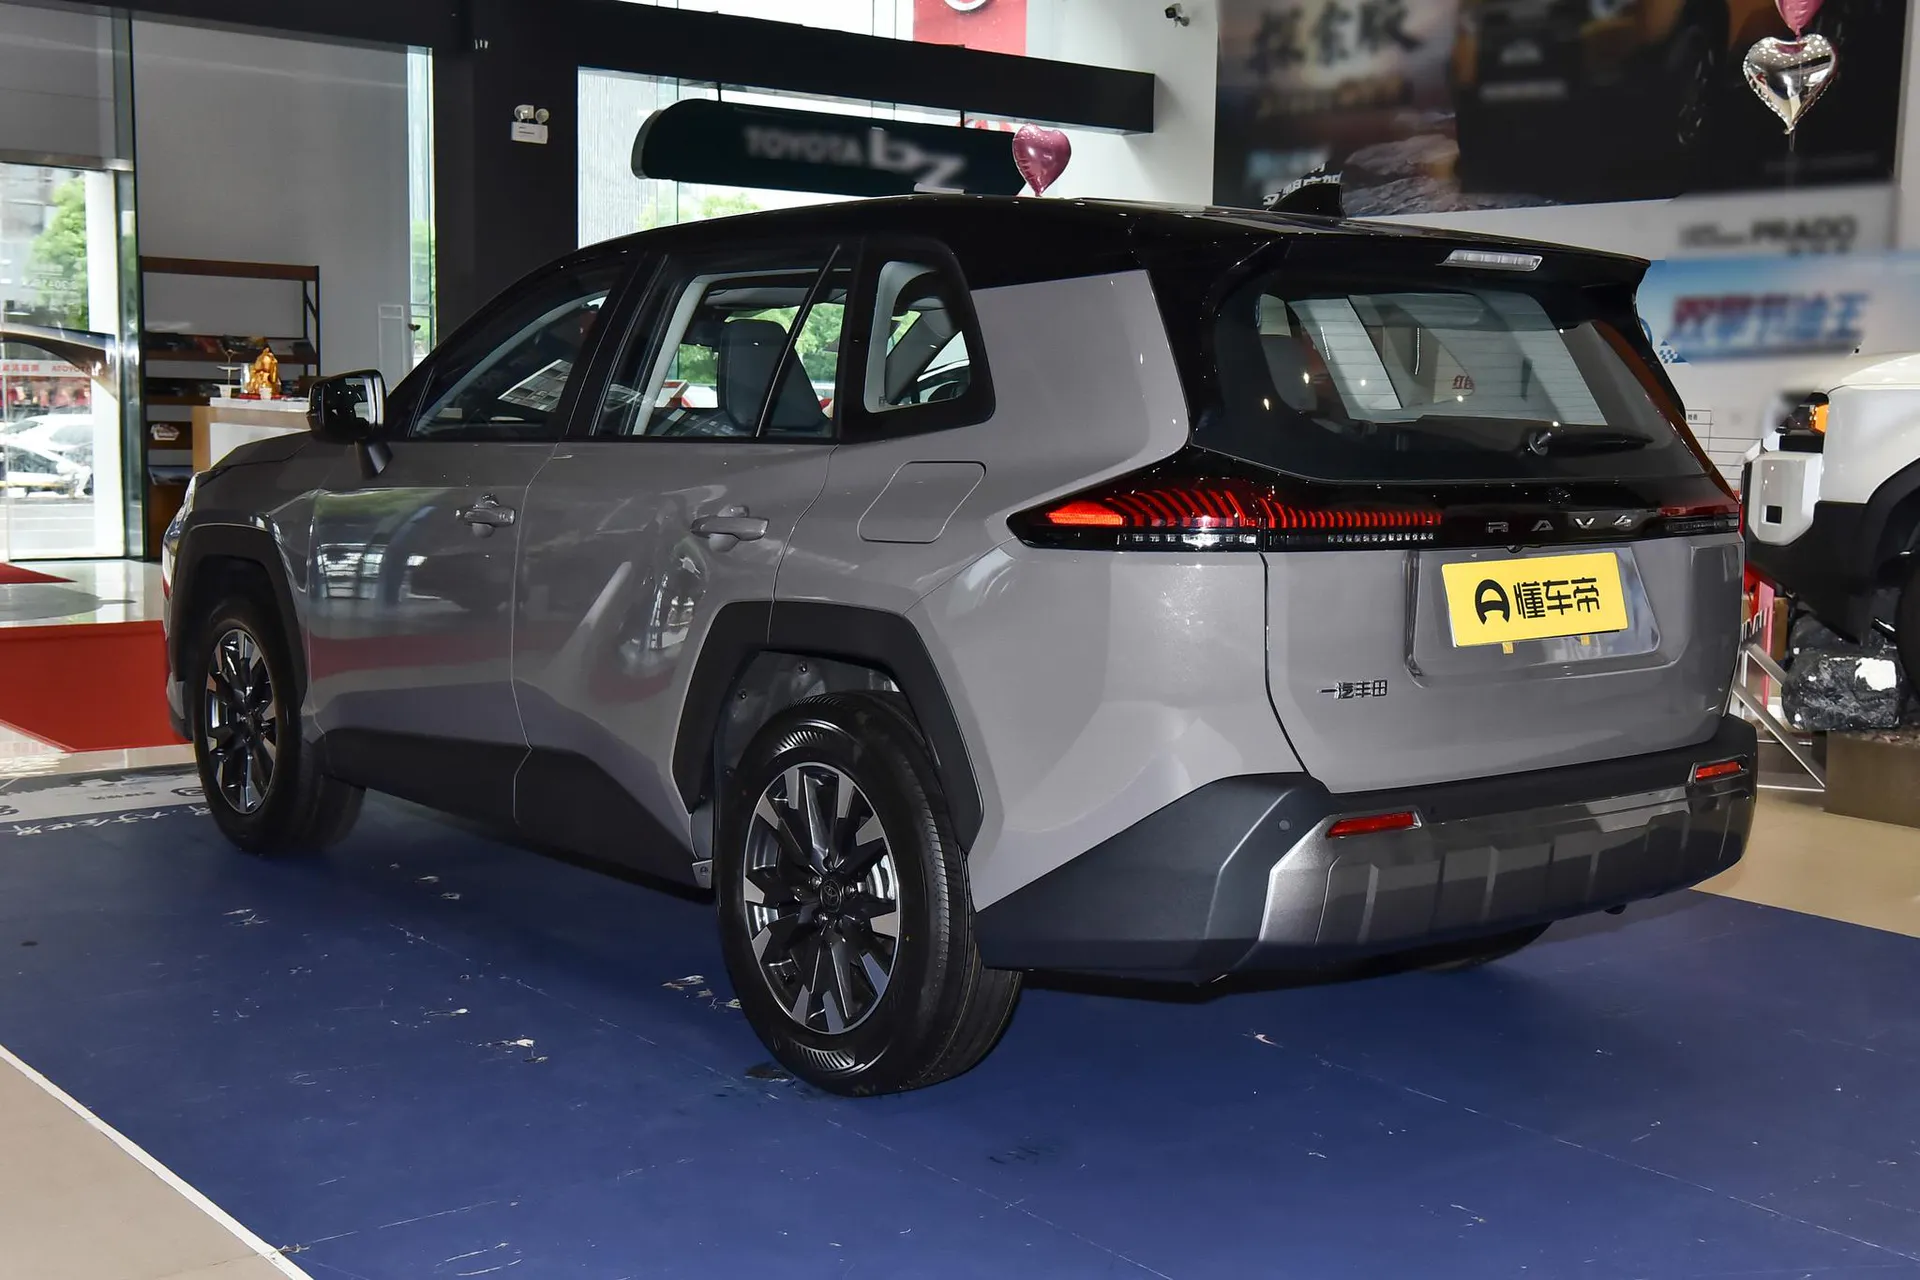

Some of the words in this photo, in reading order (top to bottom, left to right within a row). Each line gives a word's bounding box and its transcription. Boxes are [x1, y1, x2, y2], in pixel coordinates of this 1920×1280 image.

[744, 127, 862, 166] TOYOTA
[1751, 215, 1858, 241] PRADO
[1487, 515, 1632, 533] RAV4
[1513, 577, 1600, 619] 懂车帝
[1318, 680, 1388, 699] 一汽丰田
